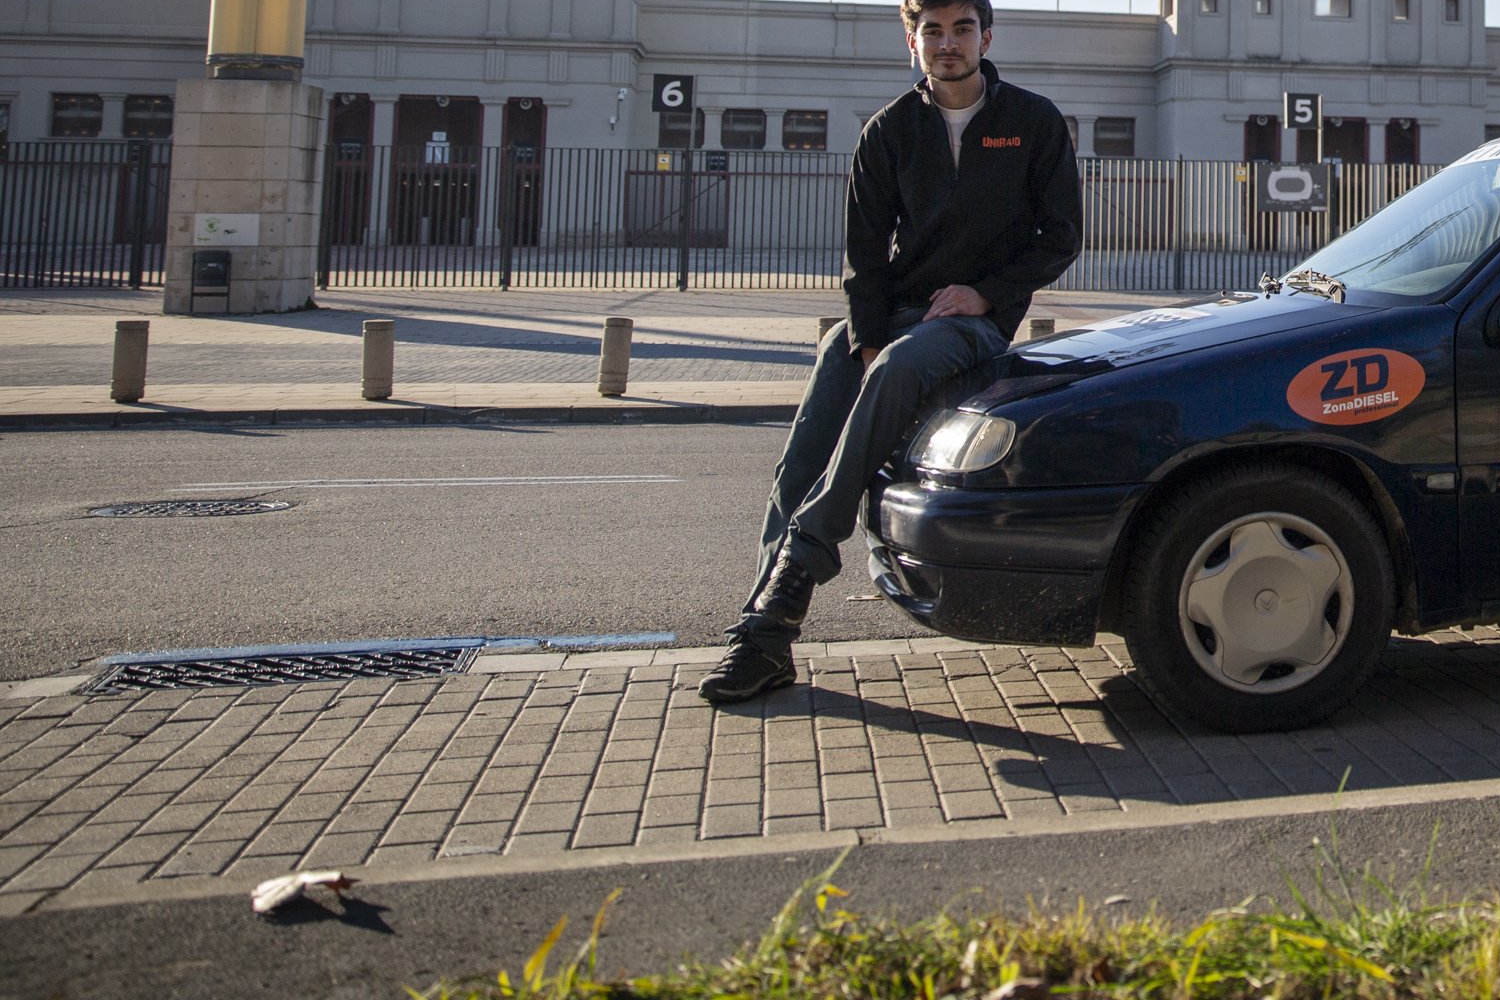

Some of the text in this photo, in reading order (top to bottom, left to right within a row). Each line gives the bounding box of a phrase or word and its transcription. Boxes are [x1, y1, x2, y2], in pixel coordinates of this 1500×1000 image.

[661, 80, 684, 107] 6
[1294, 99, 1313, 123] 5
[982, 136, 1021, 148] UNIRAID
[1320, 353, 1390, 402] ZD
[1322, 390, 1399, 415] ZonaDIESEL
